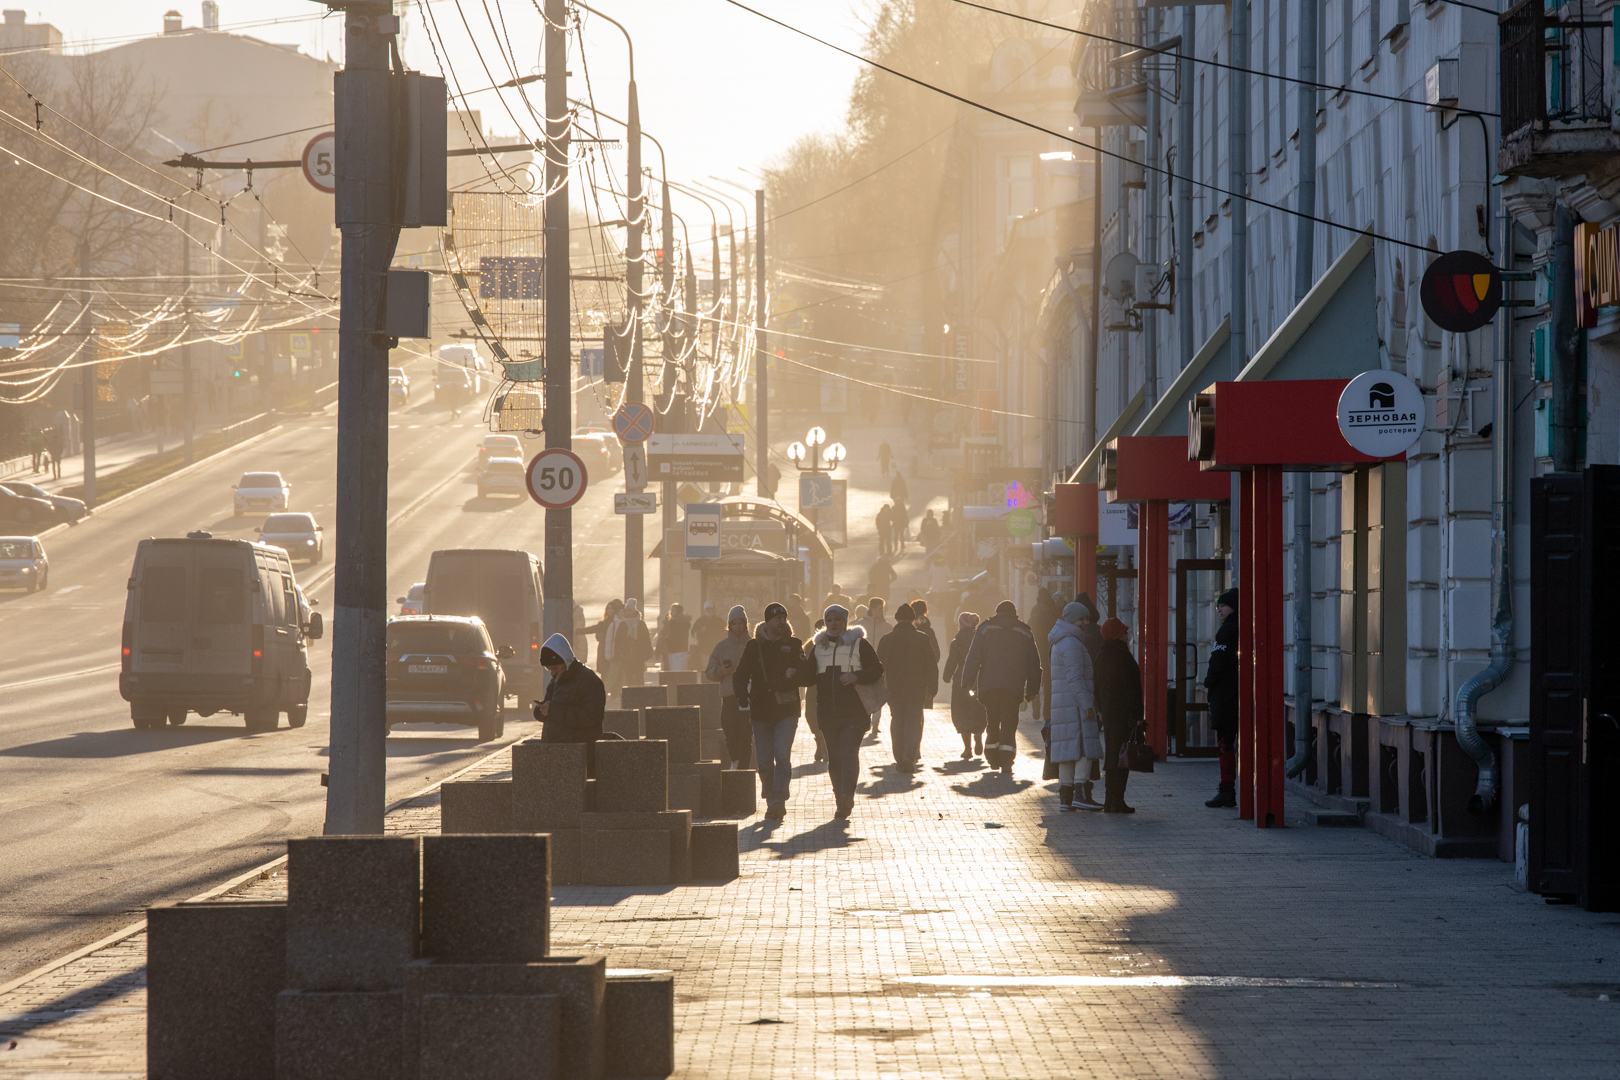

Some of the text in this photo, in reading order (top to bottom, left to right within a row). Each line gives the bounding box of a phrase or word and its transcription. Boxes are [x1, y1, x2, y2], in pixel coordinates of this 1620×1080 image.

[956, 334, 967, 390] РЕМОНТ
[1348, 413, 1416, 423] ЗЕРНОВАЯ
[540, 467, 574, 490] 50
